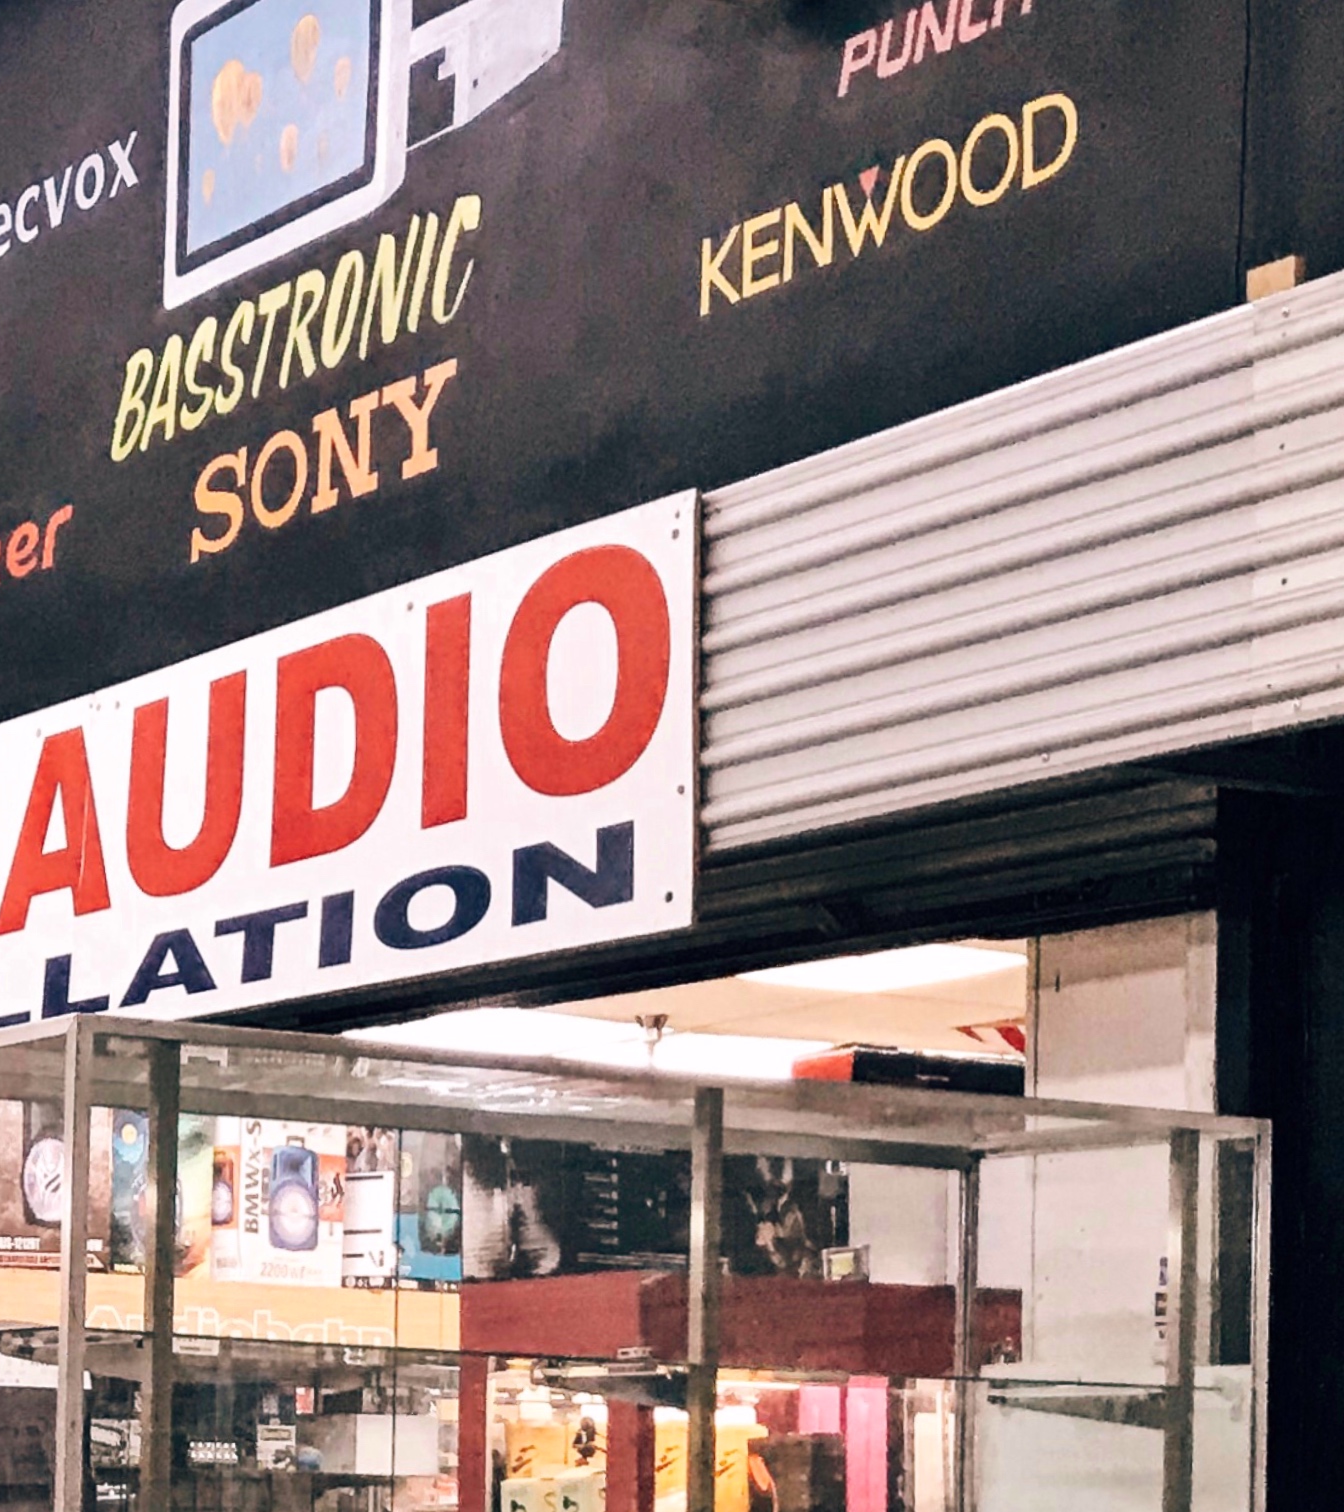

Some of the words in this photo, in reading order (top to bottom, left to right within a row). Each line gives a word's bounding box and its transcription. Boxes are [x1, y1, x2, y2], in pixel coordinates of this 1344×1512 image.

[699, 92, 1078, 317] KENWOOD
[111, 194, 482, 464] BASSTRONIC
[189, 357, 458, 564] SONY
